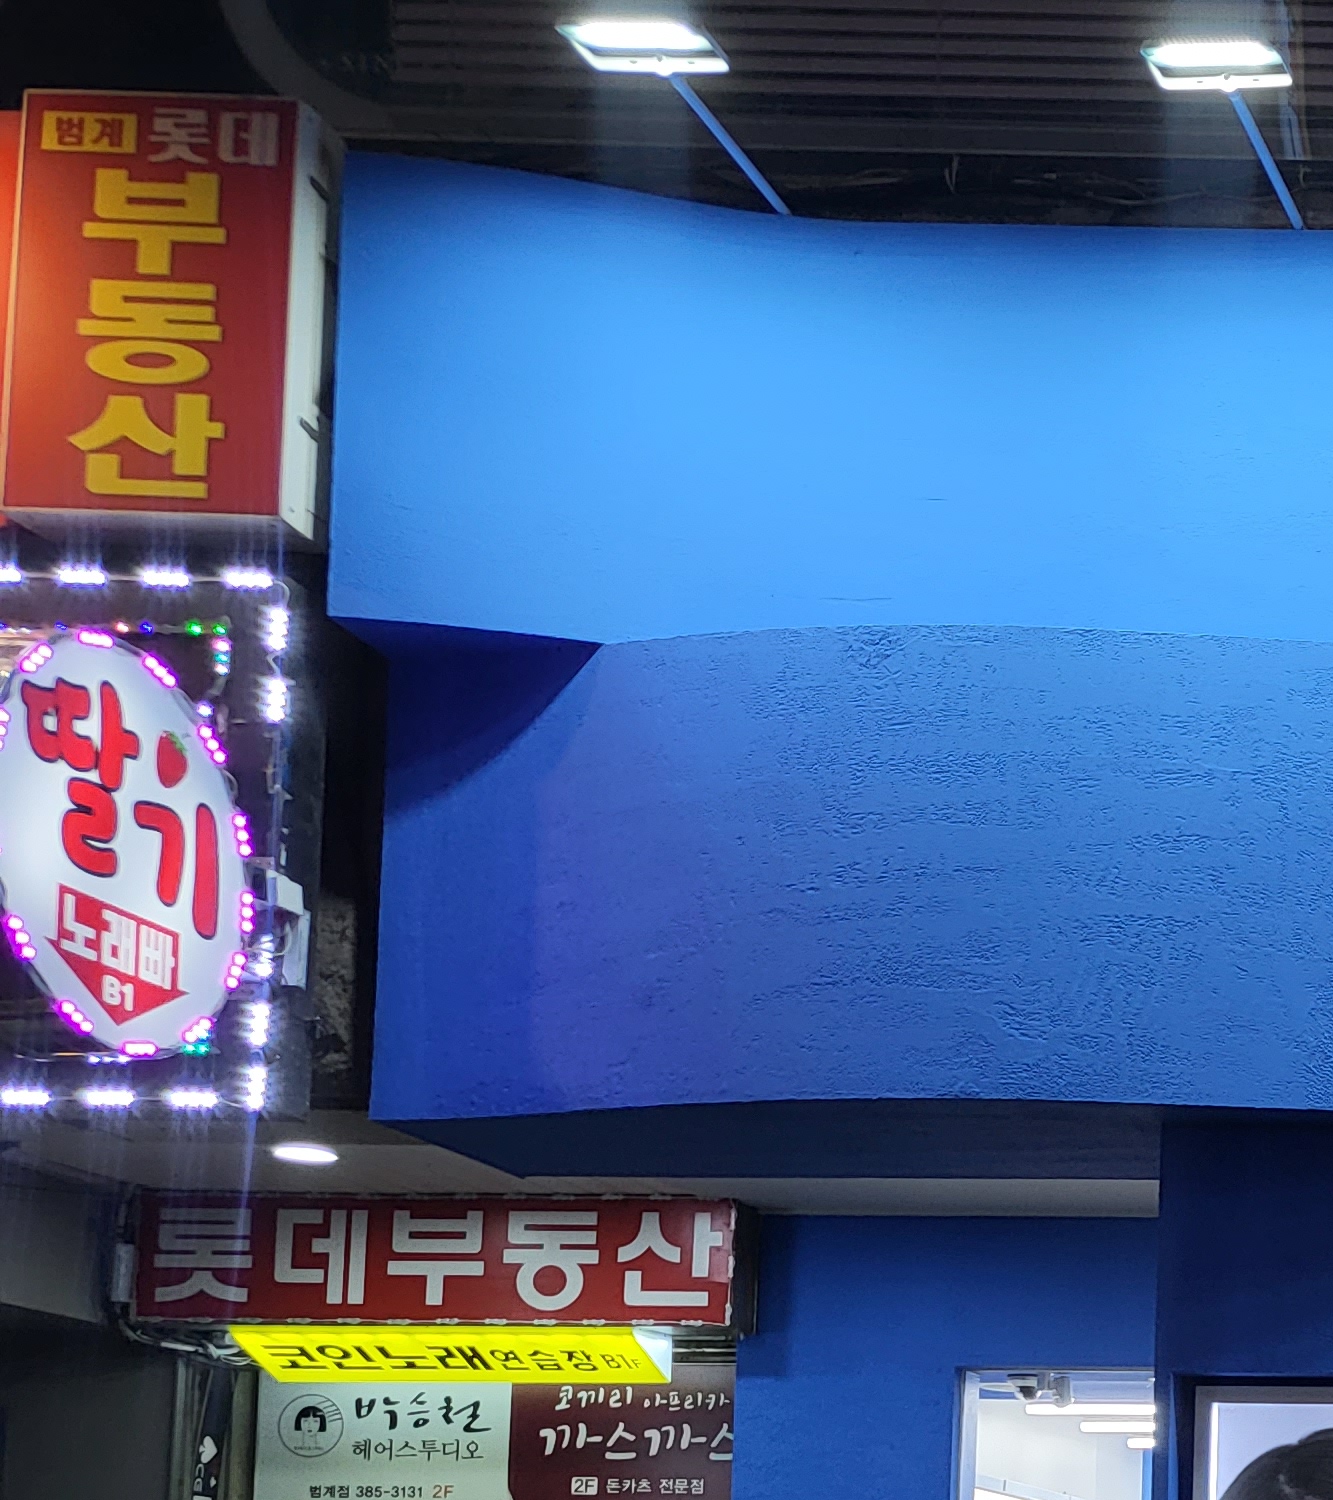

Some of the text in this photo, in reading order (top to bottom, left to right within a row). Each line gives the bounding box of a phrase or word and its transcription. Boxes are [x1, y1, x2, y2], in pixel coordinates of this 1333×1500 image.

[55, 106, 281, 167] 범계 롯데
[66, 167, 228, 500] 부동산
[20, 677, 220, 940] 딸기
[100, 975, 135, 1013] B1
[154, 1207, 725, 1311] 롯데부동산
[353, 1391, 492, 1433] 박승철
[554, 1385, 731, 1412] 코끼리 아프리카
[539, 1422, 733, 1461] 까스까스
[309, 1484, 455, 1500] 범계점 385-3131 2F
[574, 1477, 705, 1495] 2F 돈카츠 전문점
